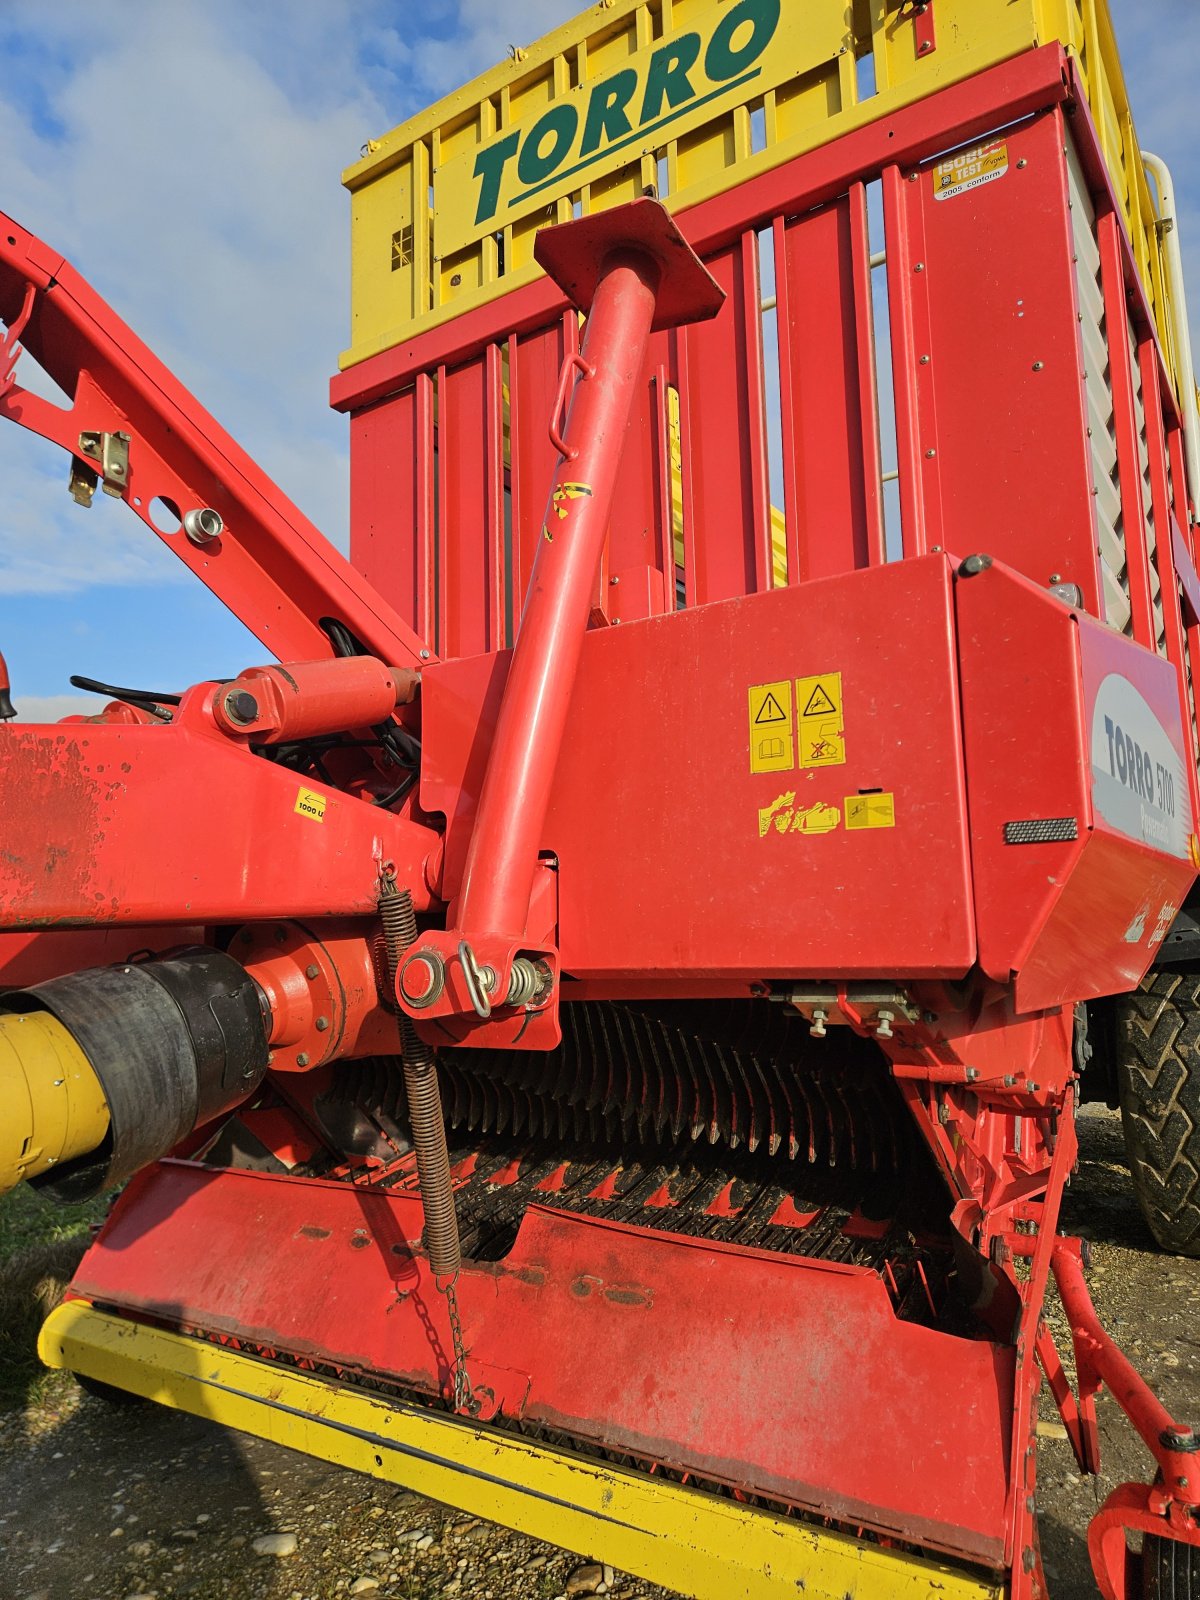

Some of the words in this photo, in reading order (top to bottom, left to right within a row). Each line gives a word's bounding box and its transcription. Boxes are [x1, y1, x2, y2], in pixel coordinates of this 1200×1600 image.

[472, 0, 781, 226] TORRO
[956, 161, 982, 180] TEST
[942, 186, 963, 198] 2005
[966, 171, 1001, 188] conform
[1104, 714, 1154, 804] TORRO
[1156, 762, 1175, 818] 5700
[299, 802, 316, 814] 1000
